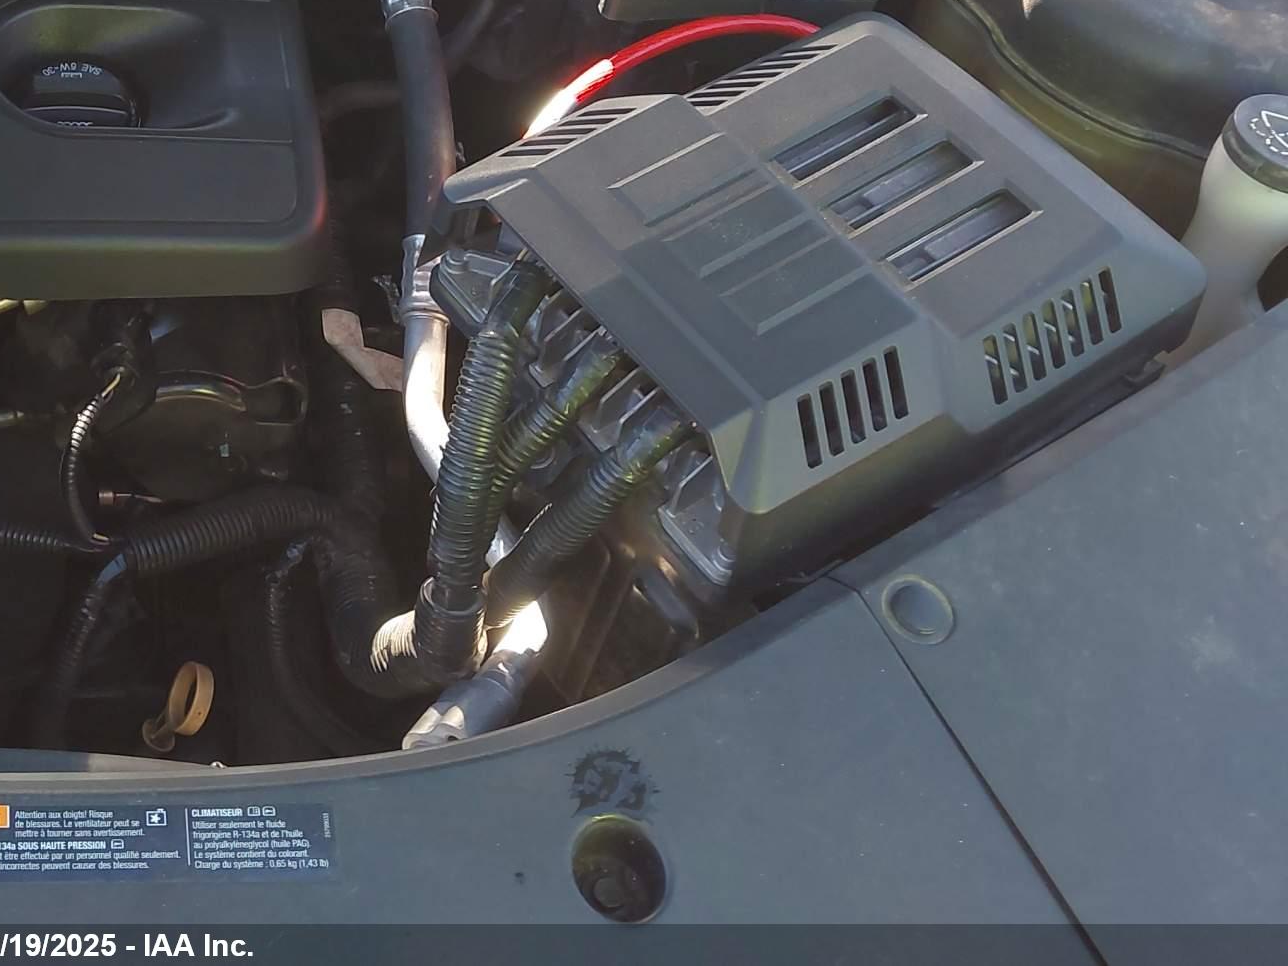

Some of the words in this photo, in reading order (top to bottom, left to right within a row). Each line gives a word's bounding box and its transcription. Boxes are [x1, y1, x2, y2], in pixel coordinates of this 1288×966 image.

[81, 63, 102, 75] SAE
[15, 810, 46, 818] Attention
[89, 810, 113, 819] Risque
[192, 809, 243, 817] CLIMATISEUR
[113, 820, 129, 828] peut
[192, 821, 216, 829] Utiliser
[219, 821, 255, 829] seulement
[258, 821, 264, 829] le
[266, 820, 286, 828] fluide
[15, 829, 38, 837] mettre
[41, 829, 45, 837] à
[47, 829, 72, 837] tourner
[74, 829, 91, 837] sans
[93, 829, 144, 837] avertissement.
[193, 831, 231, 840] frigorigène
[233, 830, 260, 838] R-134a
[262, 830, 269, 838] et
[270, 830, 280, 838] de
[282, 830, 303, 838] l'huile
[18, 841, 38, 850] SOUS
[40, 841, 66, 850] HAUTE
[68, 841, 106, 849] PRESSION
[271, 840, 290, 849] (huile
[4, 852, 18, 860] être
[20, 852, 49, 860] effectué
[52, 852, 62, 861] par
[65, 852, 74, 860] un
[76, 852, 111, 861] personnel
[141, 850, 181, 858] seulement.
[194, 851, 202, 859] Le
[205, 851, 235, 860] système
[237, 851, 265, 859] contient
[267, 851, 277, 859] du
[279, 850, 309, 858] colorant.
[0, 862, 40, 870] incorrectes
[42, 862, 70, 871] peuvent
